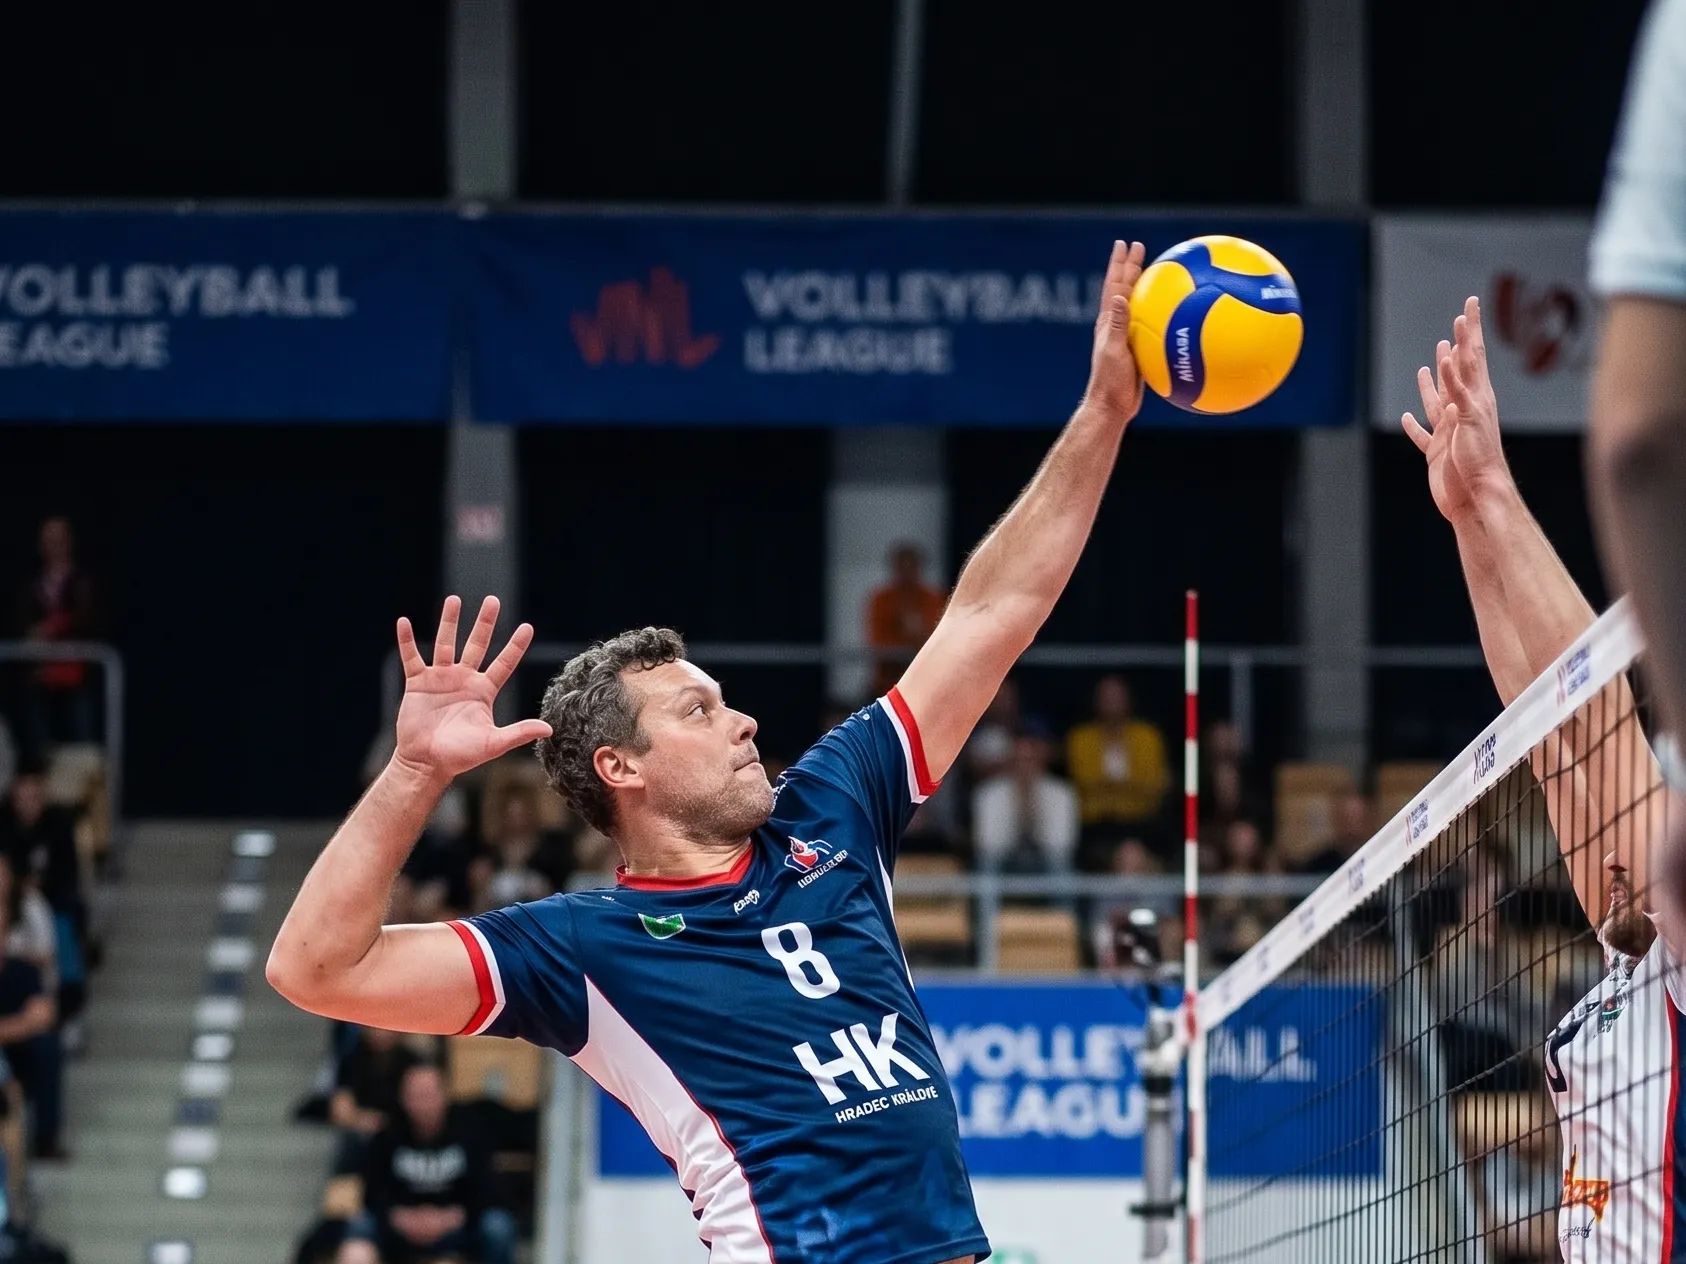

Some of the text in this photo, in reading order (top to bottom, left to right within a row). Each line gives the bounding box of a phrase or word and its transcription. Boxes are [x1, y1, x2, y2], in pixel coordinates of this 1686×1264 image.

[0, 264, 355, 317] OLLEYBALL
[0, 322, 169, 368] EAGUE
[743, 326, 952, 374] LEAGUE
[760, 921, 841, 1000] 8
[792, 1012, 931, 1106] HK
[835, 1096, 890, 1124] HRADEC
